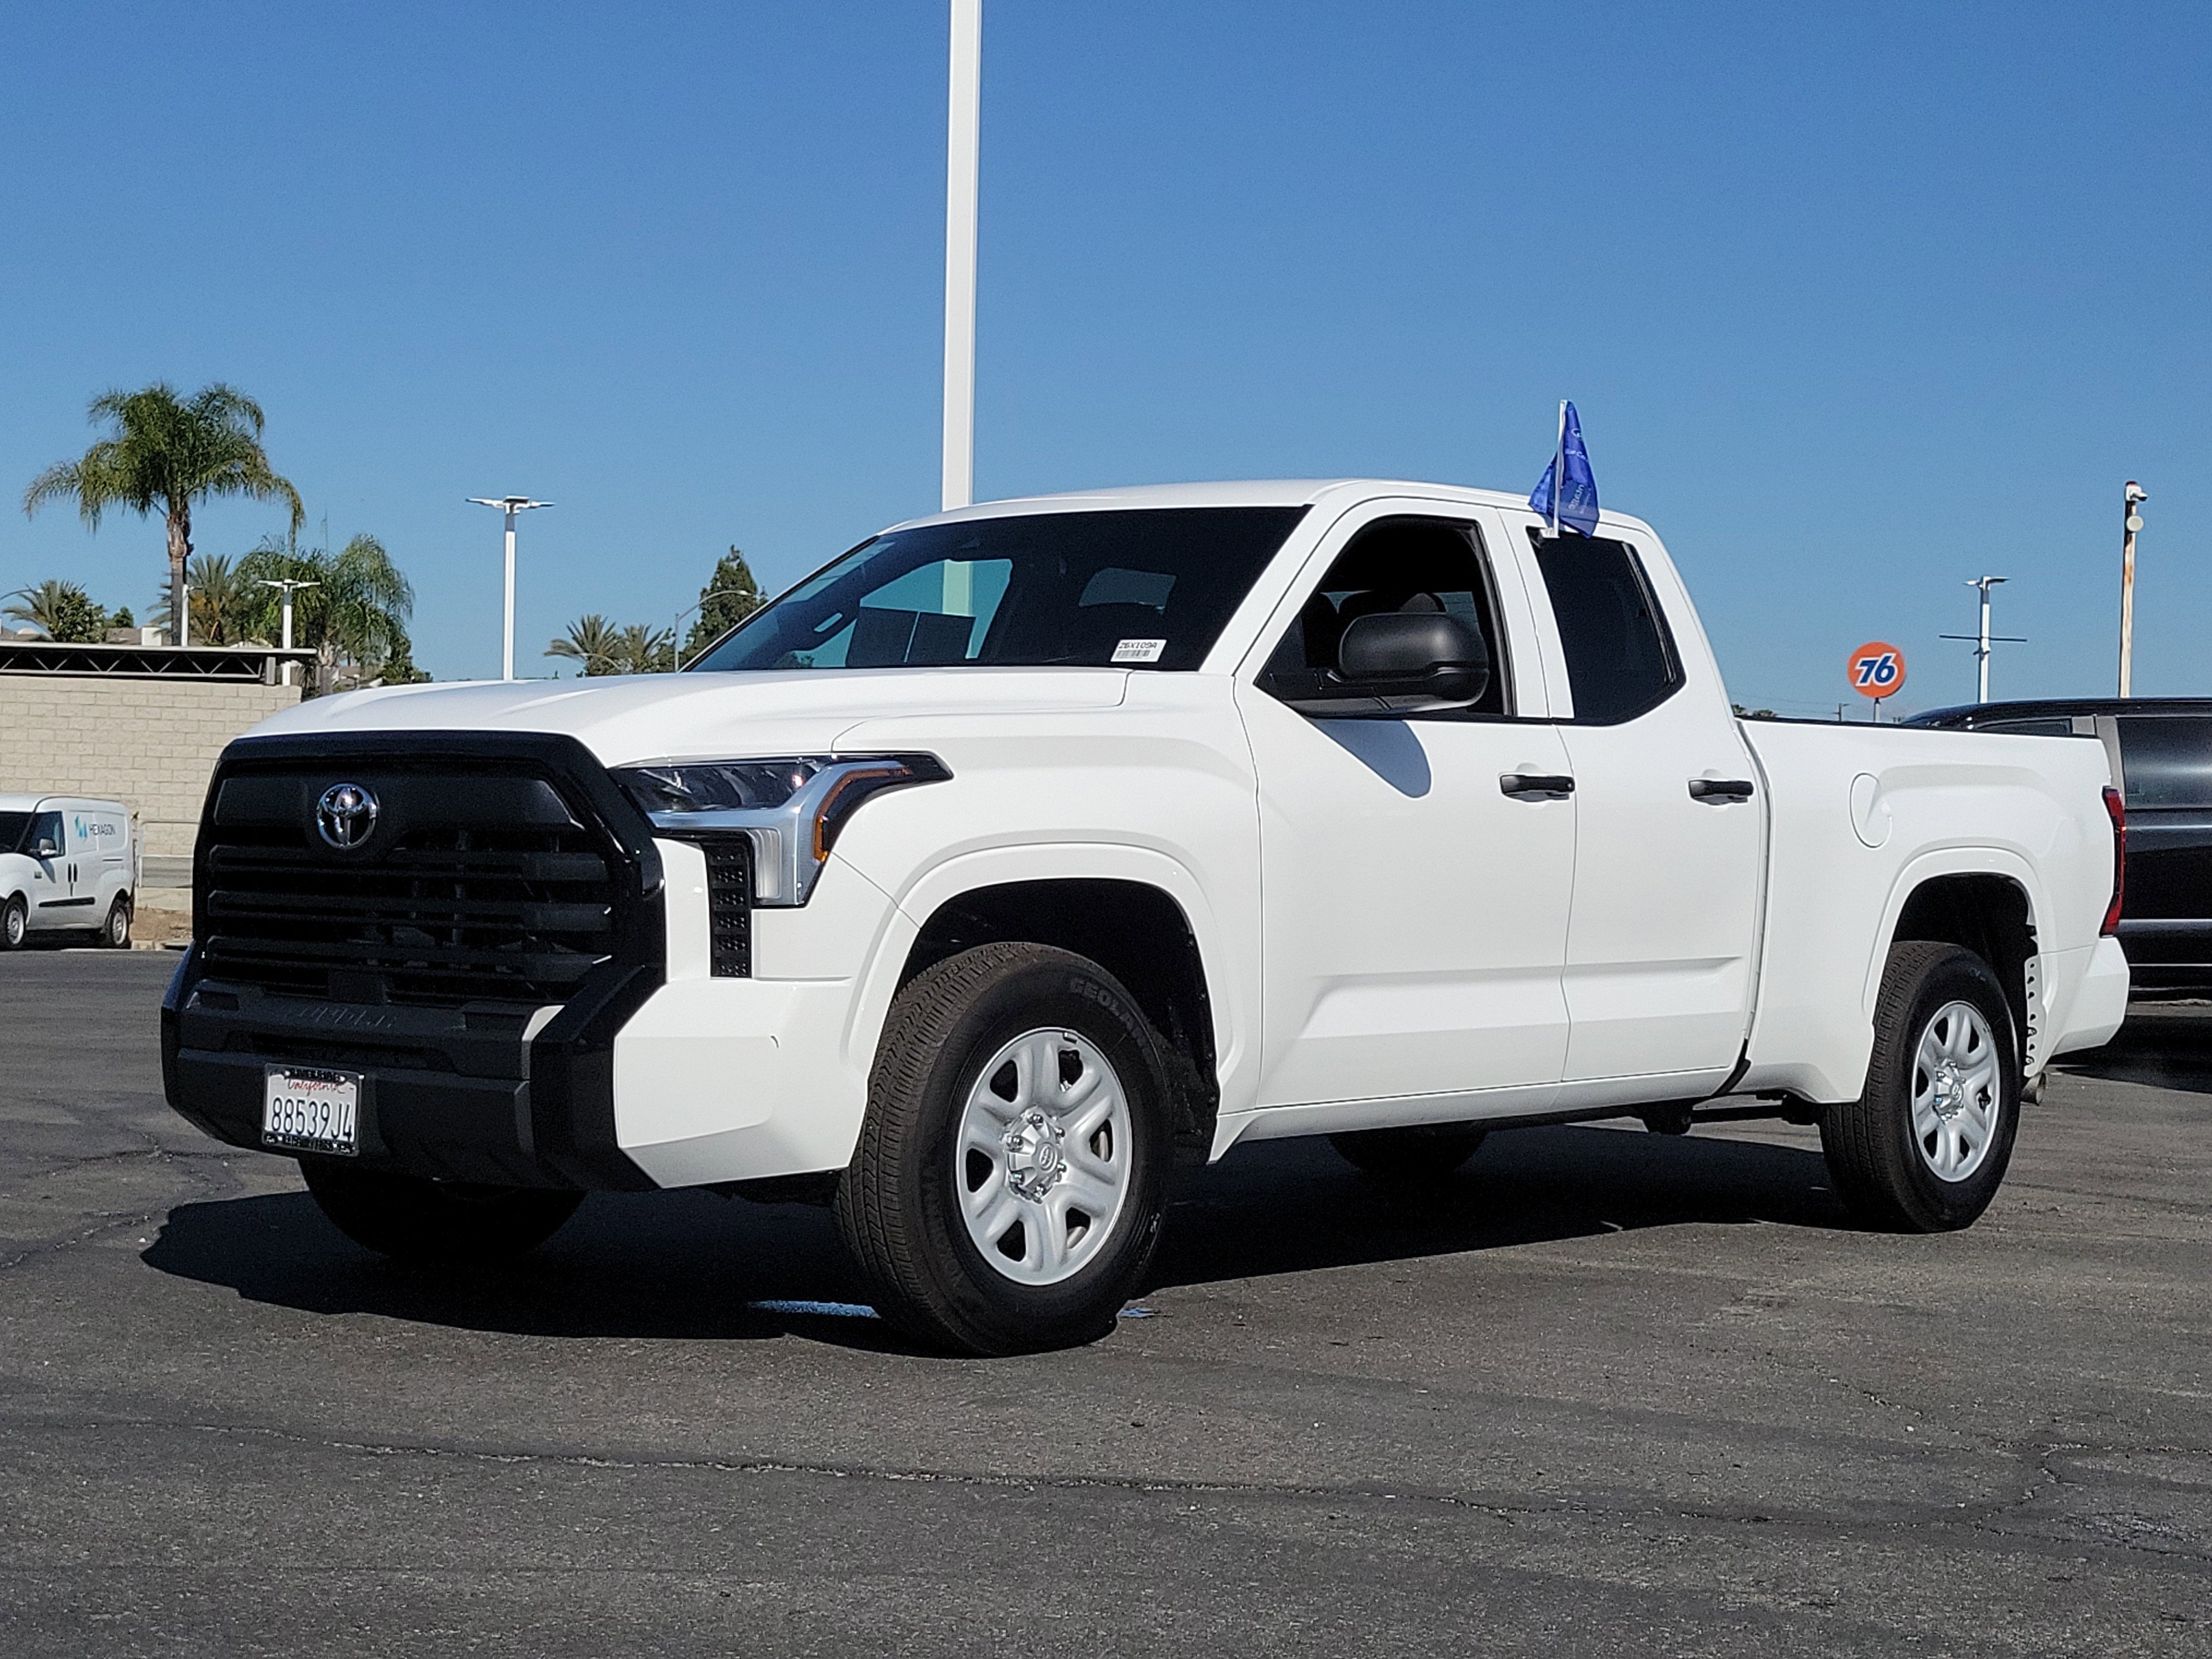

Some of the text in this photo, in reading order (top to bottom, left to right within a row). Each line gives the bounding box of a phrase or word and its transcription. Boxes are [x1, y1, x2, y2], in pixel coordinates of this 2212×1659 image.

[1855, 653, 1897, 686] 76
[89, 823, 116, 835] HEXAGON
[272, 1097, 352, 1142] 88539J4
